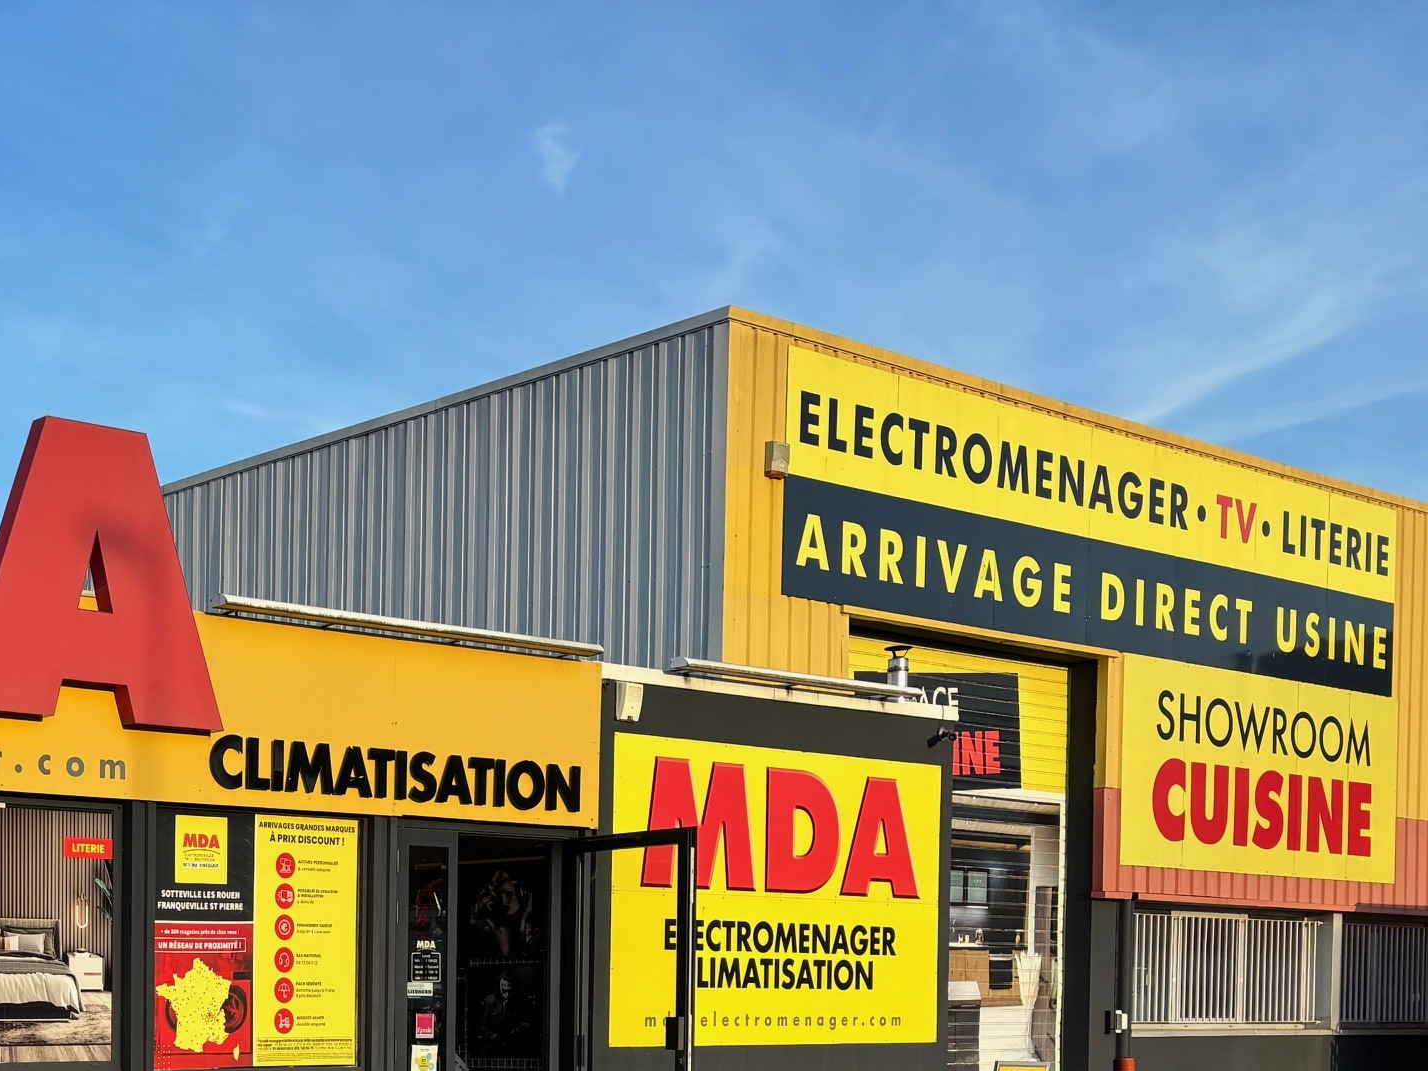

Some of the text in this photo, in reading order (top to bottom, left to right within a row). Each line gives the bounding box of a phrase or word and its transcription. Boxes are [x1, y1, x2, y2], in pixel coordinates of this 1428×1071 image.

[799, 390, 1390, 577] ELECTROMENAGER TV LITERIE
[795, 513, 1388, 671] ARRIVAGE DIRECT USINE
[1156, 689, 1371, 767] SHOWROOM
[211, 732, 579, 814] CLIMATISATION
[1152, 758, 1372, 858] CUISINE
[259, 822, 355, 834] ARRIVAGES GRANDES MARQUES
[270, 831, 276, 842] À
[277, 834, 297, 843] PRIX
[298, 835, 340, 845] DISCOUNT
[640, 756, 920, 899] MDA
[71, 842, 105, 855] LITERIE
[183, 833, 220, 849] MDA
[161, 890, 240, 900] SOTTEVILLE LES ROUEN
[158, 901, 244, 911] FRANQUEVILLE ST PIERRE
[158, 941, 168, 949] UN
[169, 940, 193, 950] RÉSEAU
[194, 941, 203, 950] DE
[204, 940, 238, 950] PROXIMITÉ
[416, 940, 436, 949] MDA
[664, 918, 896, 957] EECTROMENAGER
[696, 957, 874, 990] LIMATISATION
[644, 1010, 902, 1031] melectromenager.com
